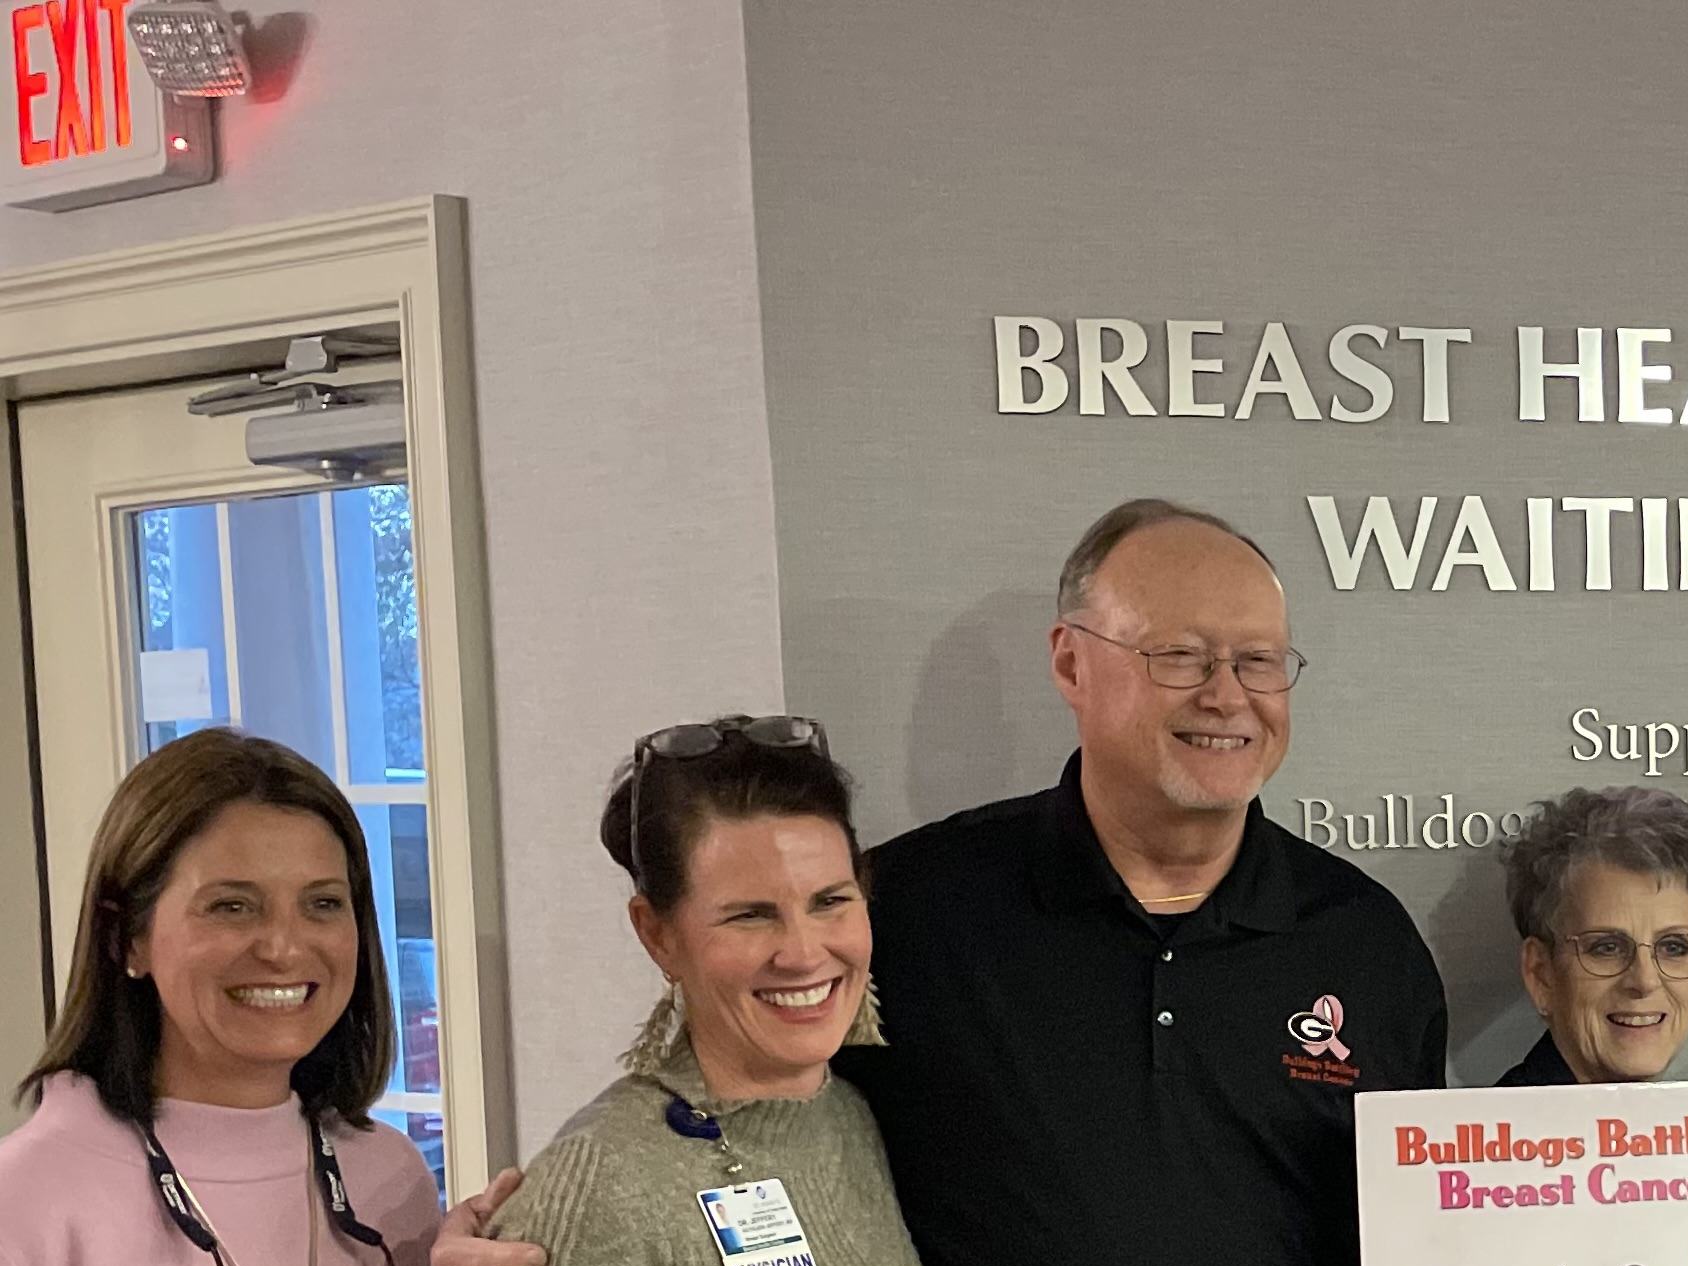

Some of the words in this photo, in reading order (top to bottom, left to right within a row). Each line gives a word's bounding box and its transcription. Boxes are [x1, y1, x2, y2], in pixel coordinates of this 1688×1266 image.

[13, 0, 132, 166] EXIT
[994, 316, 1472, 423] BREAST
[1298, 793, 1524, 851] Bulldo
[1395, 1123, 1585, 1168] Bulldogs
[1438, 1170, 1575, 1210] Breast
